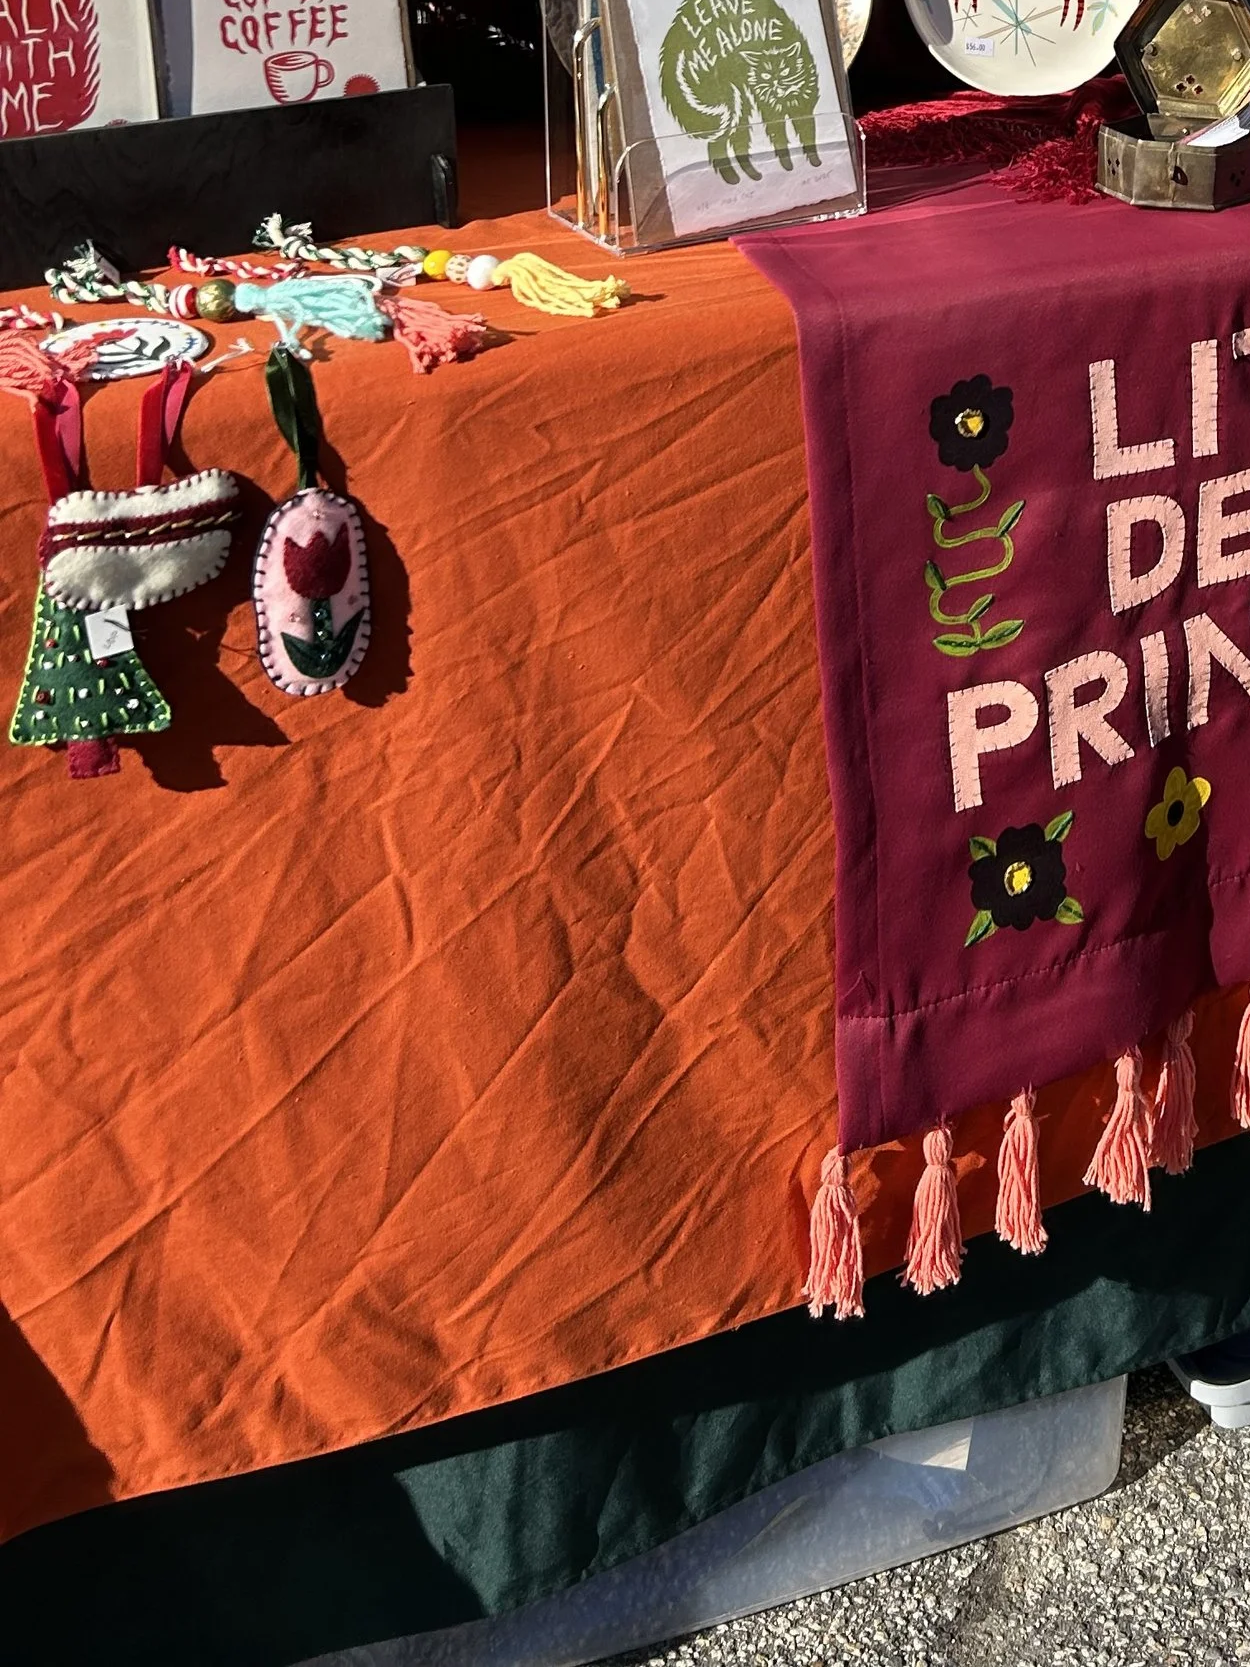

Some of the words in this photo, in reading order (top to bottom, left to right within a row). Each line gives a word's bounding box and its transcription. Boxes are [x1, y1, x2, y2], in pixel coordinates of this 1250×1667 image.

[220, 5, 349, 54] COFFEE
[687, 37, 718, 84] ME
[715, 18, 783, 58] ALONE
[0, 38, 76, 82] ITH
[0, 82, 64, 135] ME
